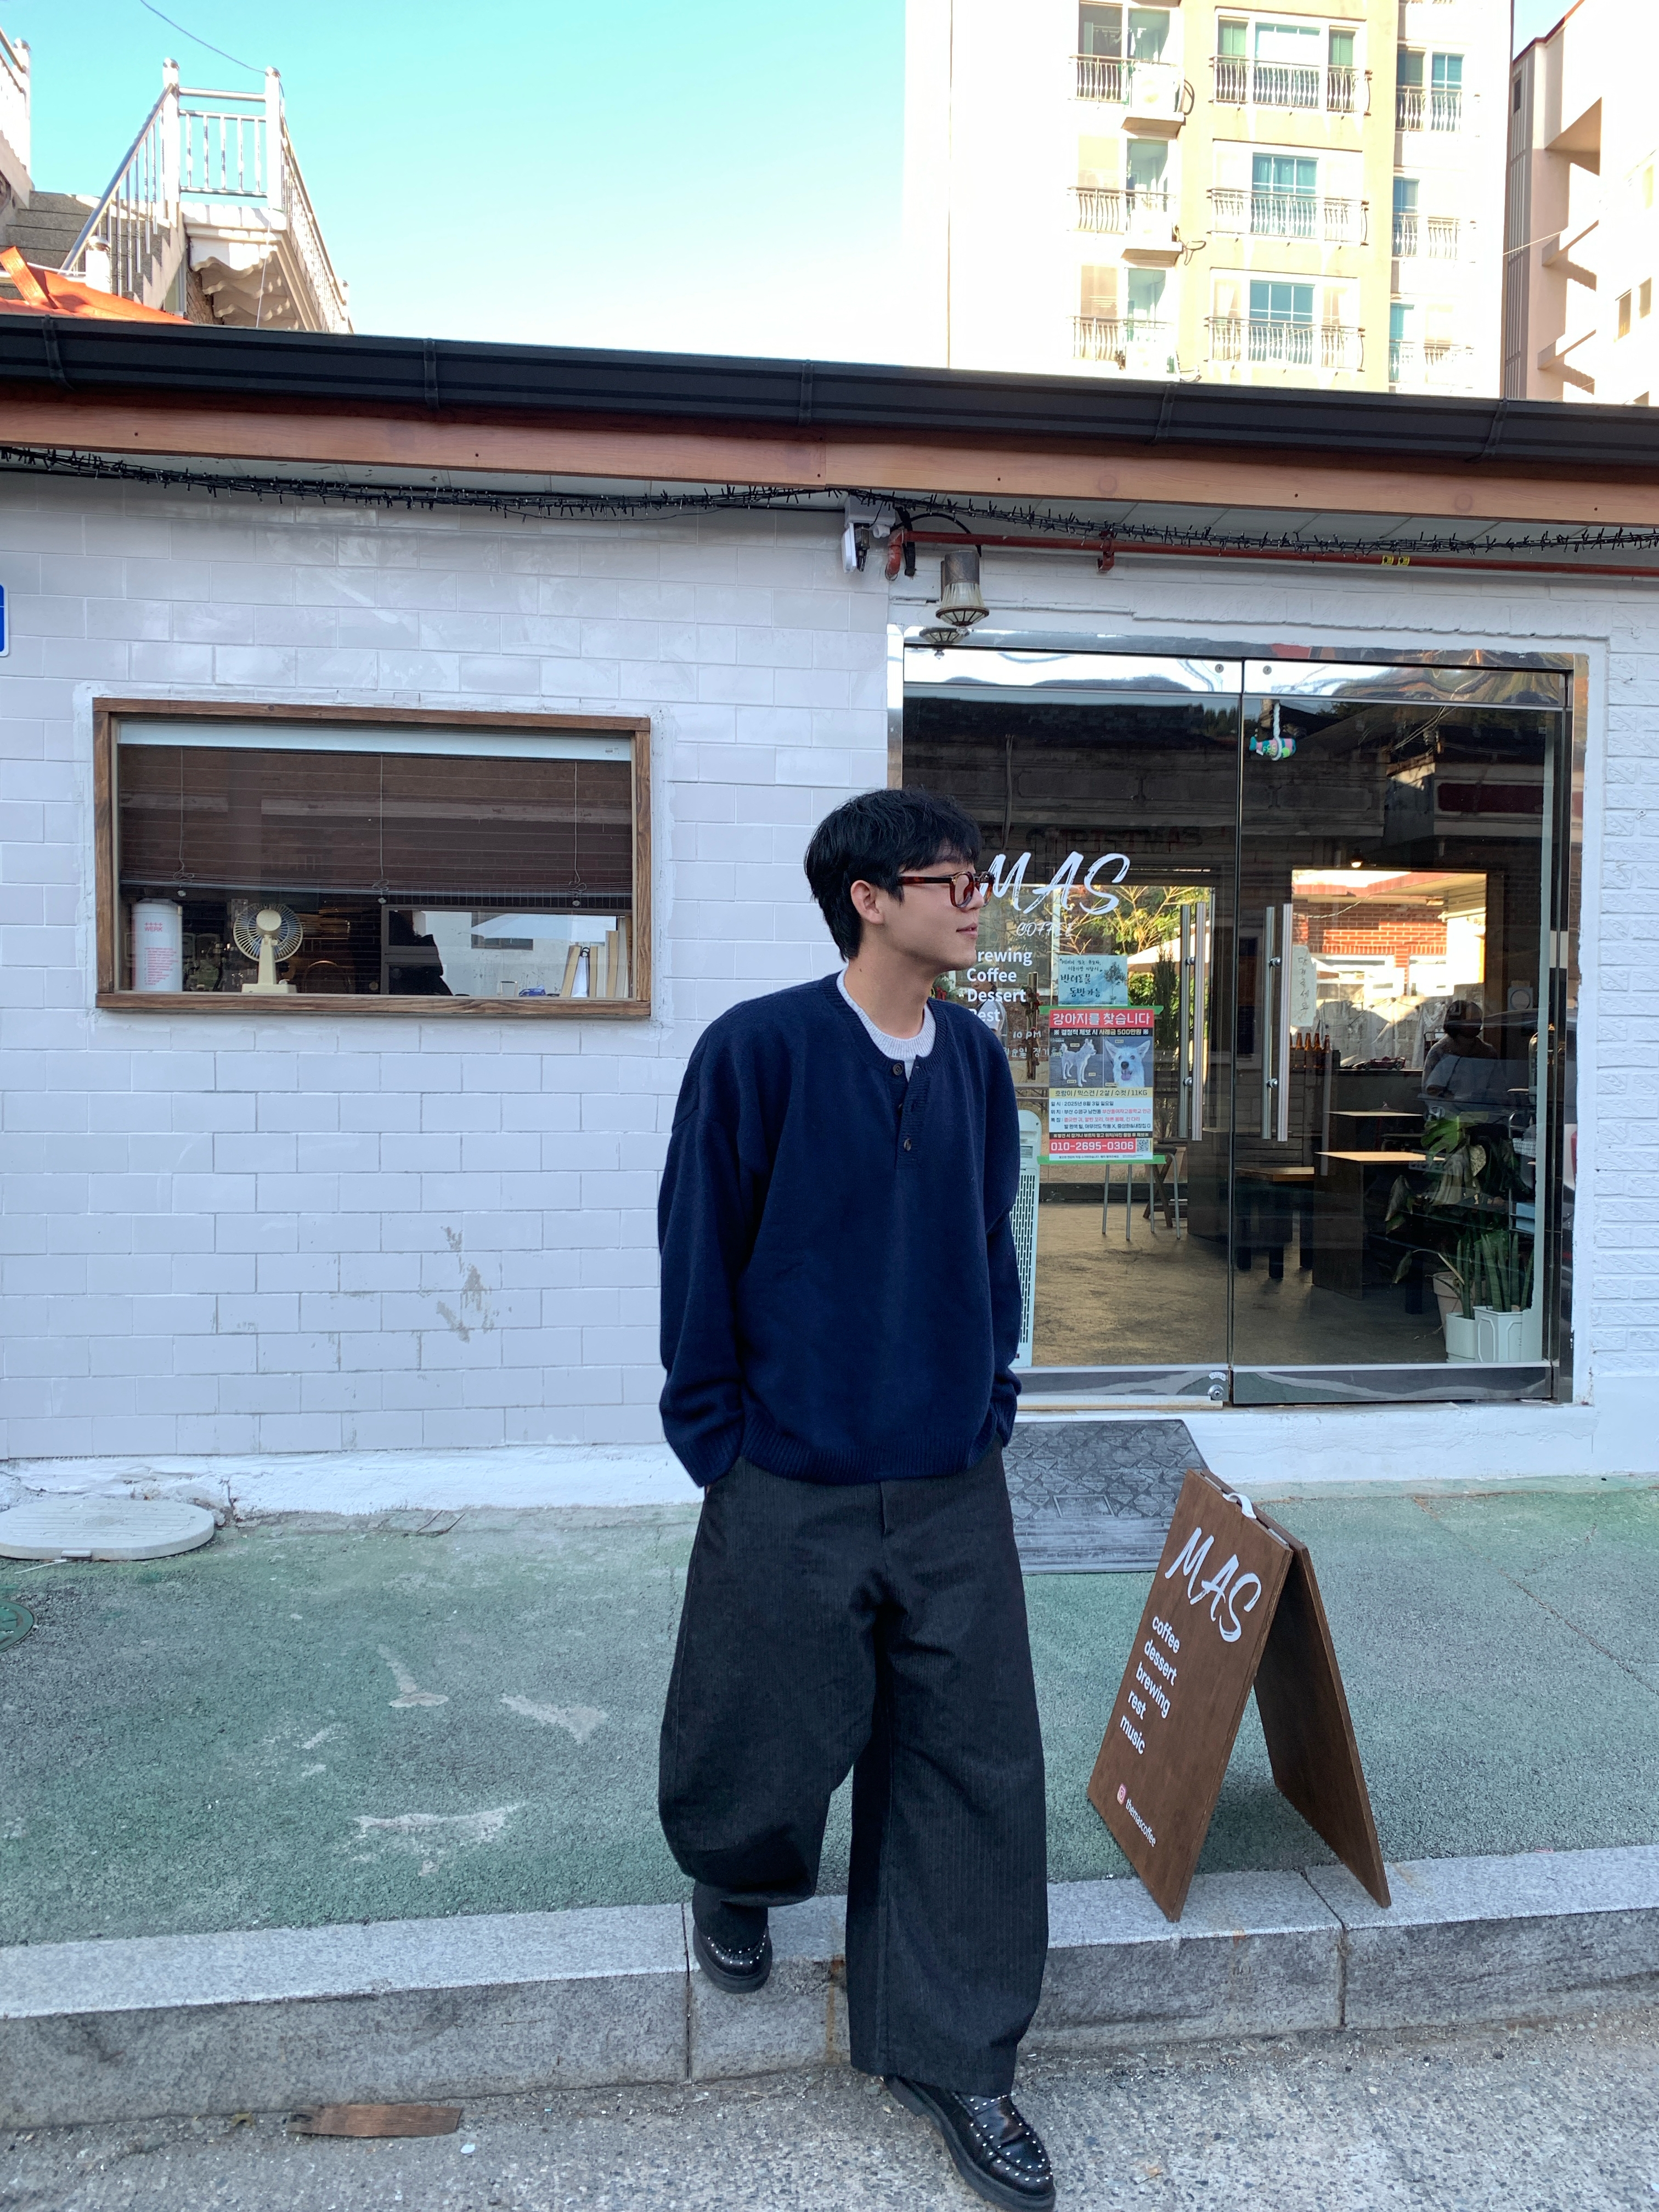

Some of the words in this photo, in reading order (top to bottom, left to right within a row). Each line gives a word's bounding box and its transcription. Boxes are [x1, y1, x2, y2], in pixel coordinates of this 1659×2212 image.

[979, 851, 1130, 915] MAS
[1017, 921, 1077, 938] COFFEE
[978, 947, 1033, 966] rewing
[967, 968, 1017, 983] Coffee
[1060, 974, 1091, 984] 반려동물
[968, 989, 1026, 1002] Dessert
[1053, 1013, 1100, 1025] 강아지를
[1103, 1013, 1150, 1025] 찾습니다
[1025, 1030, 1042, 1040] PM
[1051, 1142, 1134, 1151] 010-2695-0306
[1165, 1527, 1261, 1642] MAS
[1152, 1616, 1180, 1654] coffee
[1144, 1639, 1177, 1686] dessert
[1136, 1661, 1171, 1719] brewing
[1128, 1690, 1147, 1720] rest
[1120, 1715, 1145, 1754] music
[1126, 1798, 1156, 1848] themascoffee
